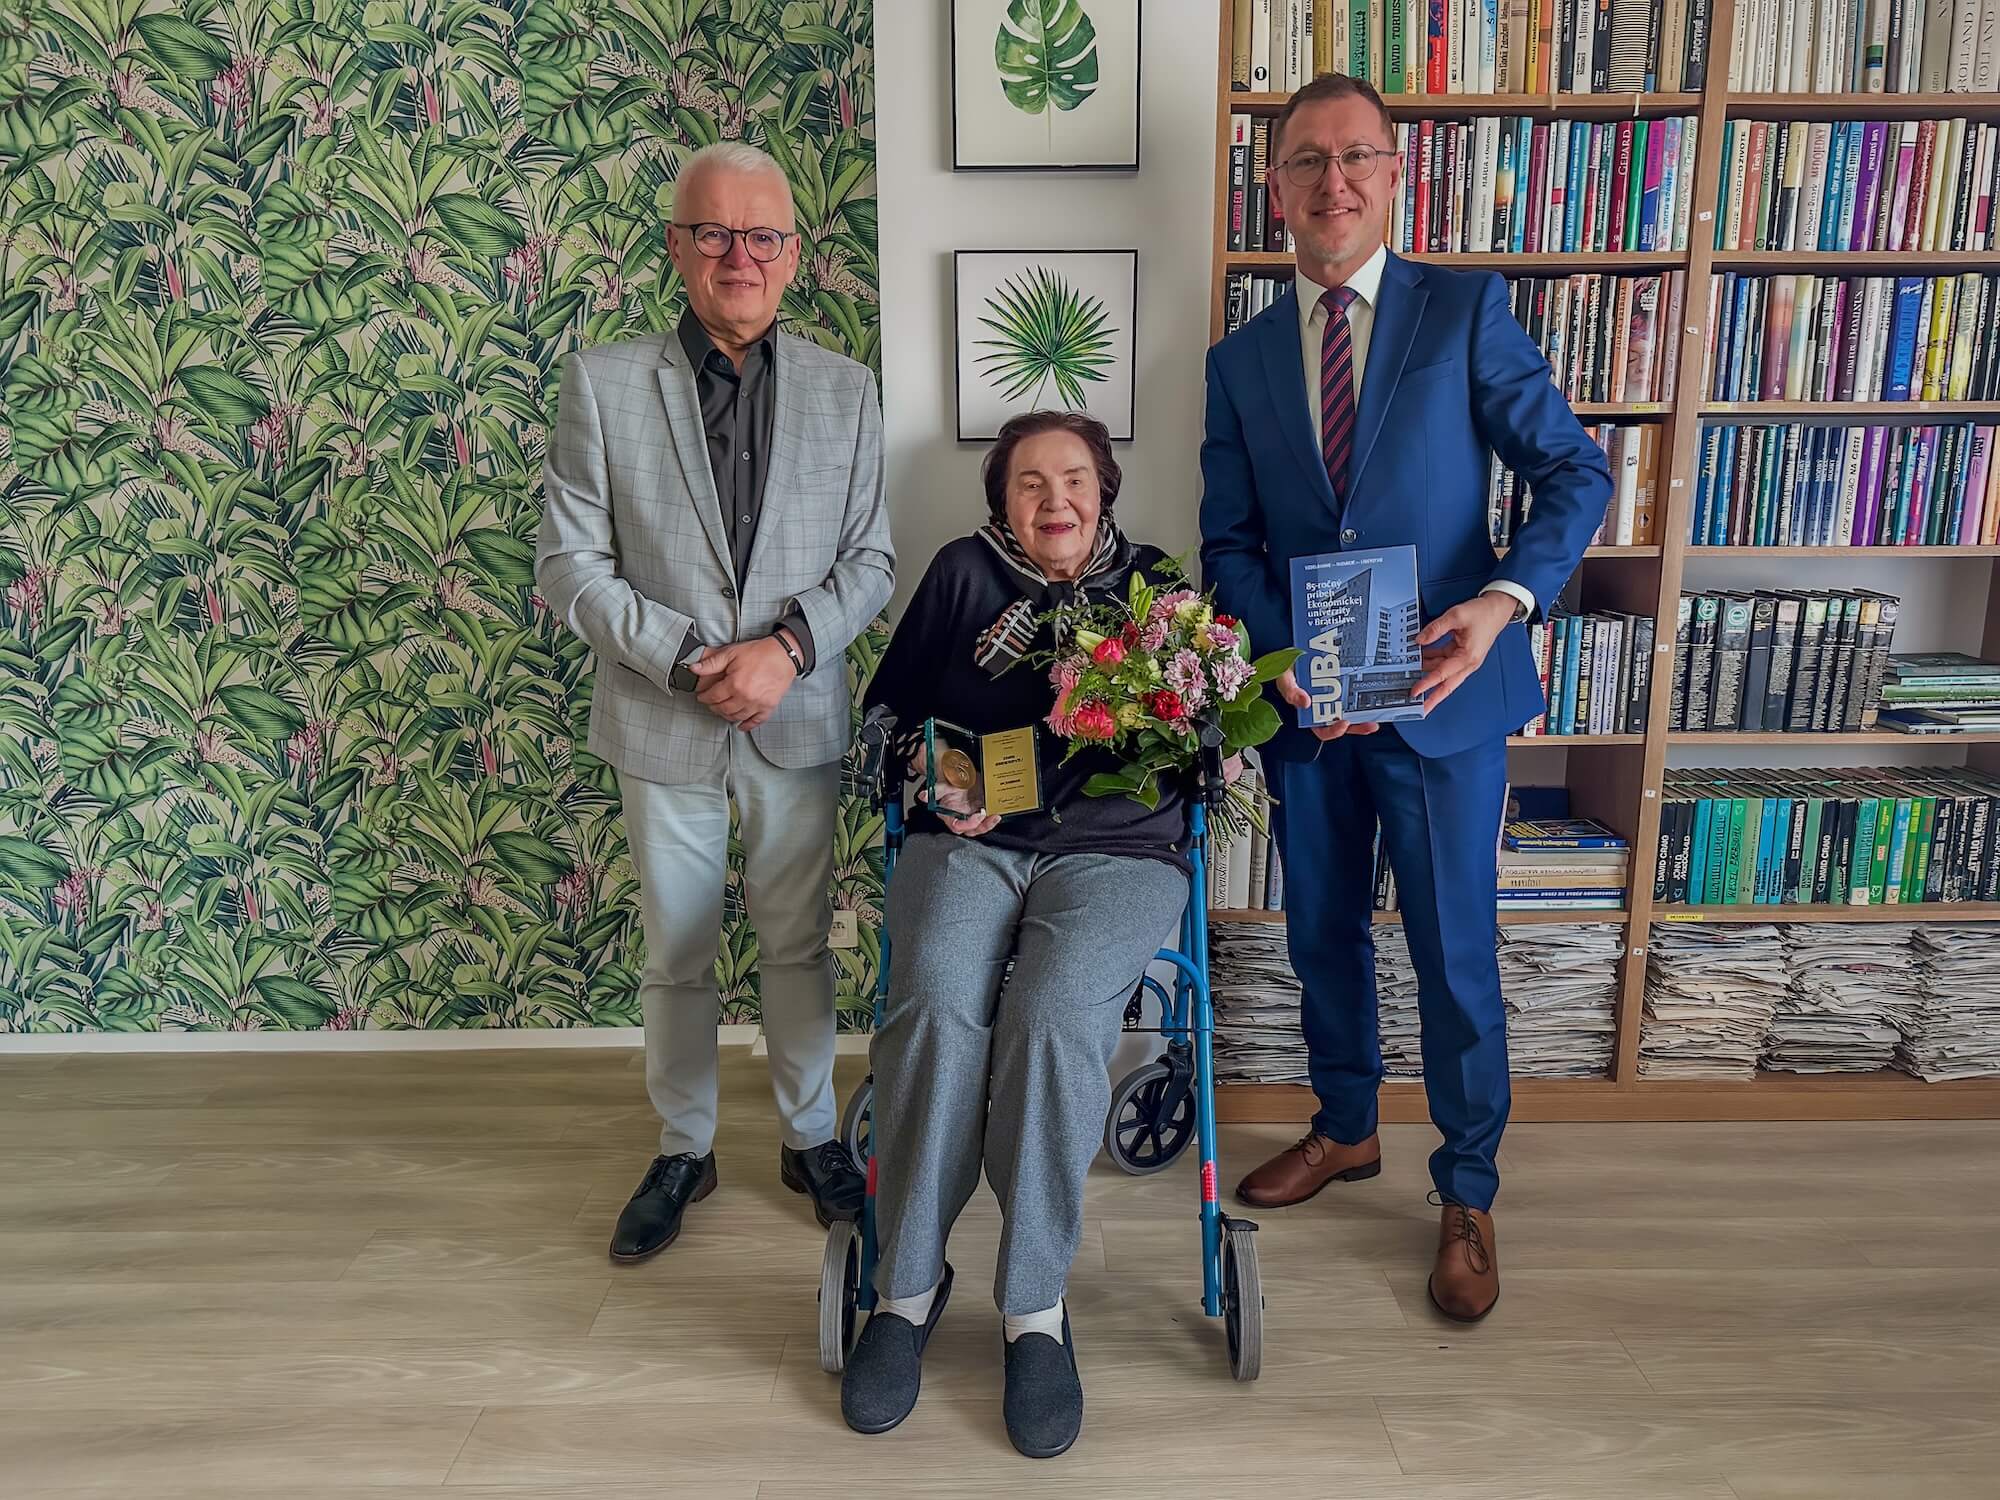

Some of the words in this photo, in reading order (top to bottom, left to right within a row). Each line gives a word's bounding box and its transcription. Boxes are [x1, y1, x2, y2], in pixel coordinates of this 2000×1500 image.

[1391, 44, 1401, 74] DAVID
[1957, 12, 1973, 89] ROLLAND
[1978, 11, 1994, 88] ROLLAND
[1755, 128, 1764, 151] vetra
[1617, 129, 1631, 176] GEPARD
[1810, 128, 1825, 178] MEDOJEDKY
[1232, 190, 1242, 203] ECO
[1851, 435, 1861, 460] CESTE
[1849, 463, 1857, 475] NA
[1844, 477, 1855, 515] KEROUAC
[1841, 518, 1849, 539] JACK
[1305, 580, 1342, 591] 85-ročný
[1307, 596, 1362, 609] Ekonomickej
[1308, 607, 1351, 618] univerzity
[1314, 616, 1356, 627] Bratislave
[1596, 628, 1606, 662] NÁVRAOV
[1309, 628, 1344, 725] EUBA
[1971, 802, 1986, 839] VERALDI
[1658, 834, 1669, 859] CRAIG
[1821, 834, 1831, 859] CRAIG
[1967, 840, 1980, 872] ATTILIO
[1656, 860, 1667, 882] DAVID
[1673, 861, 1681, 881] JOHN
[1818, 860, 1827, 882] DAVID
[1727, 870, 1738, 898] WESSEL
